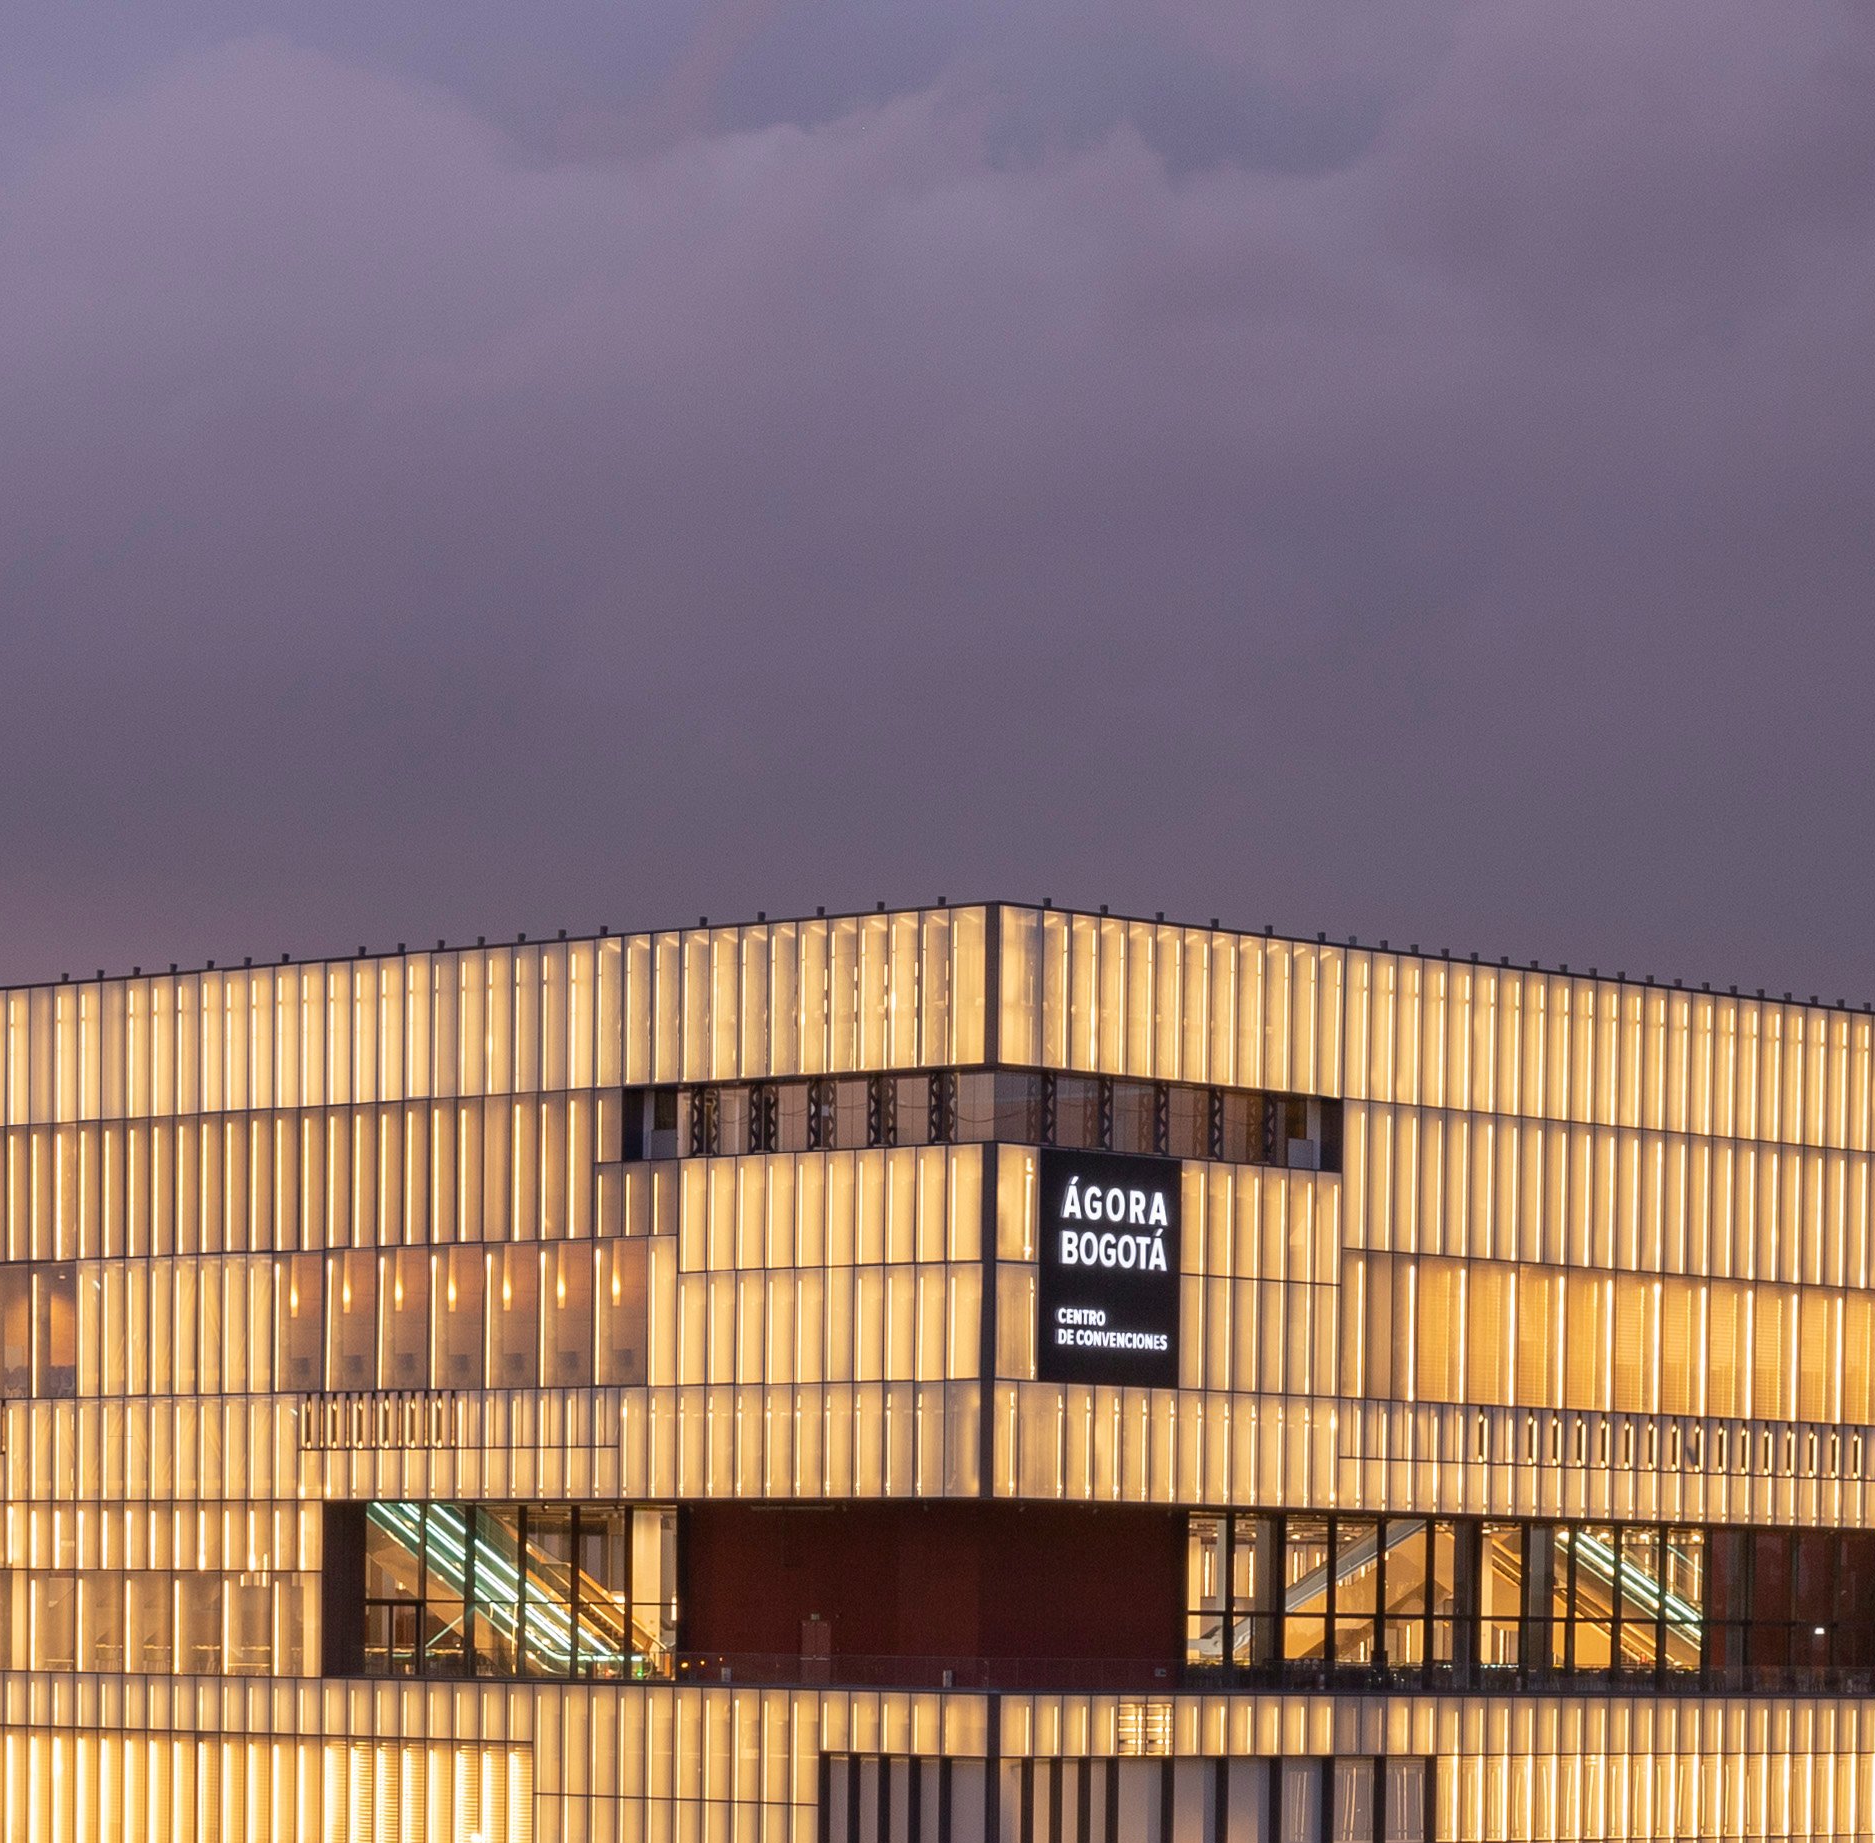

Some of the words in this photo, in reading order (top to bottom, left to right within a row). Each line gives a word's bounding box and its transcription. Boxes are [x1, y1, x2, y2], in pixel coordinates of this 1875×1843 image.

[1061, 1176, 1168, 1226] ÁGORA
[1060, 1229, 1167, 1272] BOGOTÁ
[1057, 1308, 1106, 1326] CENTRO
[1057, 1329, 1074, 1345] DE
[1076, 1330, 1168, 1351] CONVENCIONES
